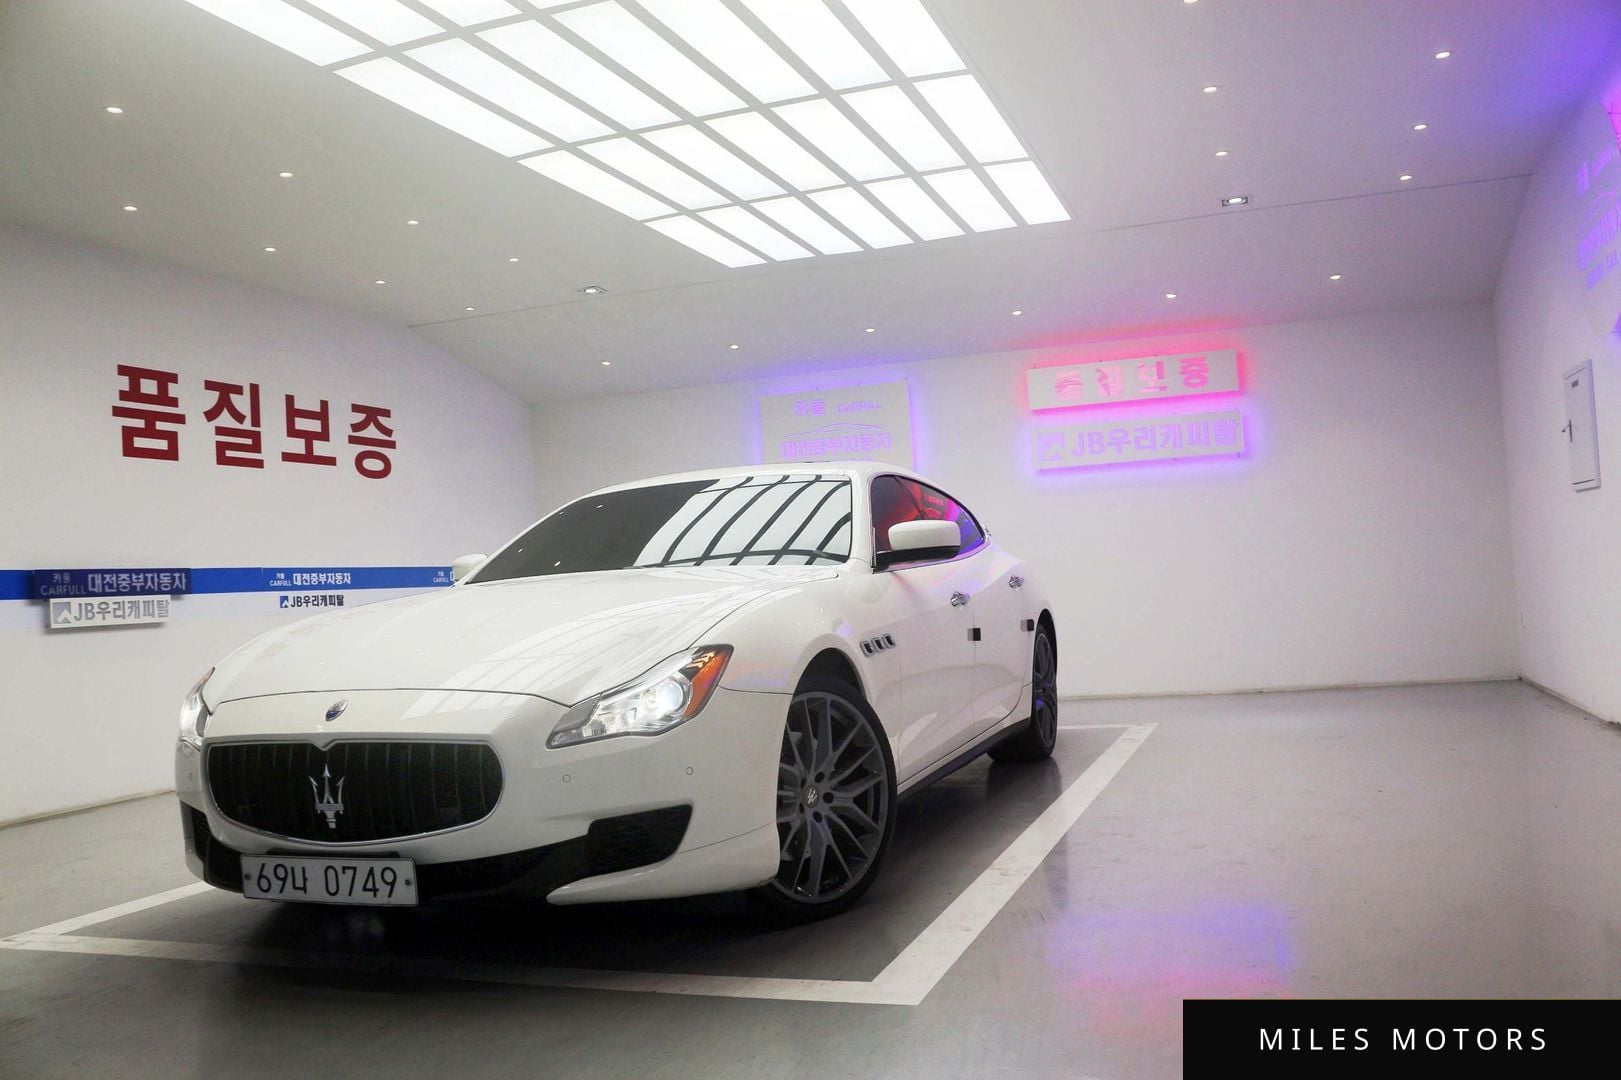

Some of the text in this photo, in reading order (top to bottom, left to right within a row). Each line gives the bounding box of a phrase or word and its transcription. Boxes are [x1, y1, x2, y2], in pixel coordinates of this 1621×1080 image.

[112, 364, 397, 479] 품질보증
[40, 584, 86, 596] CARFULL
[74, 600, 169, 621] JB우리캐피탈
[256, 863, 397, 898] 69나 0749
